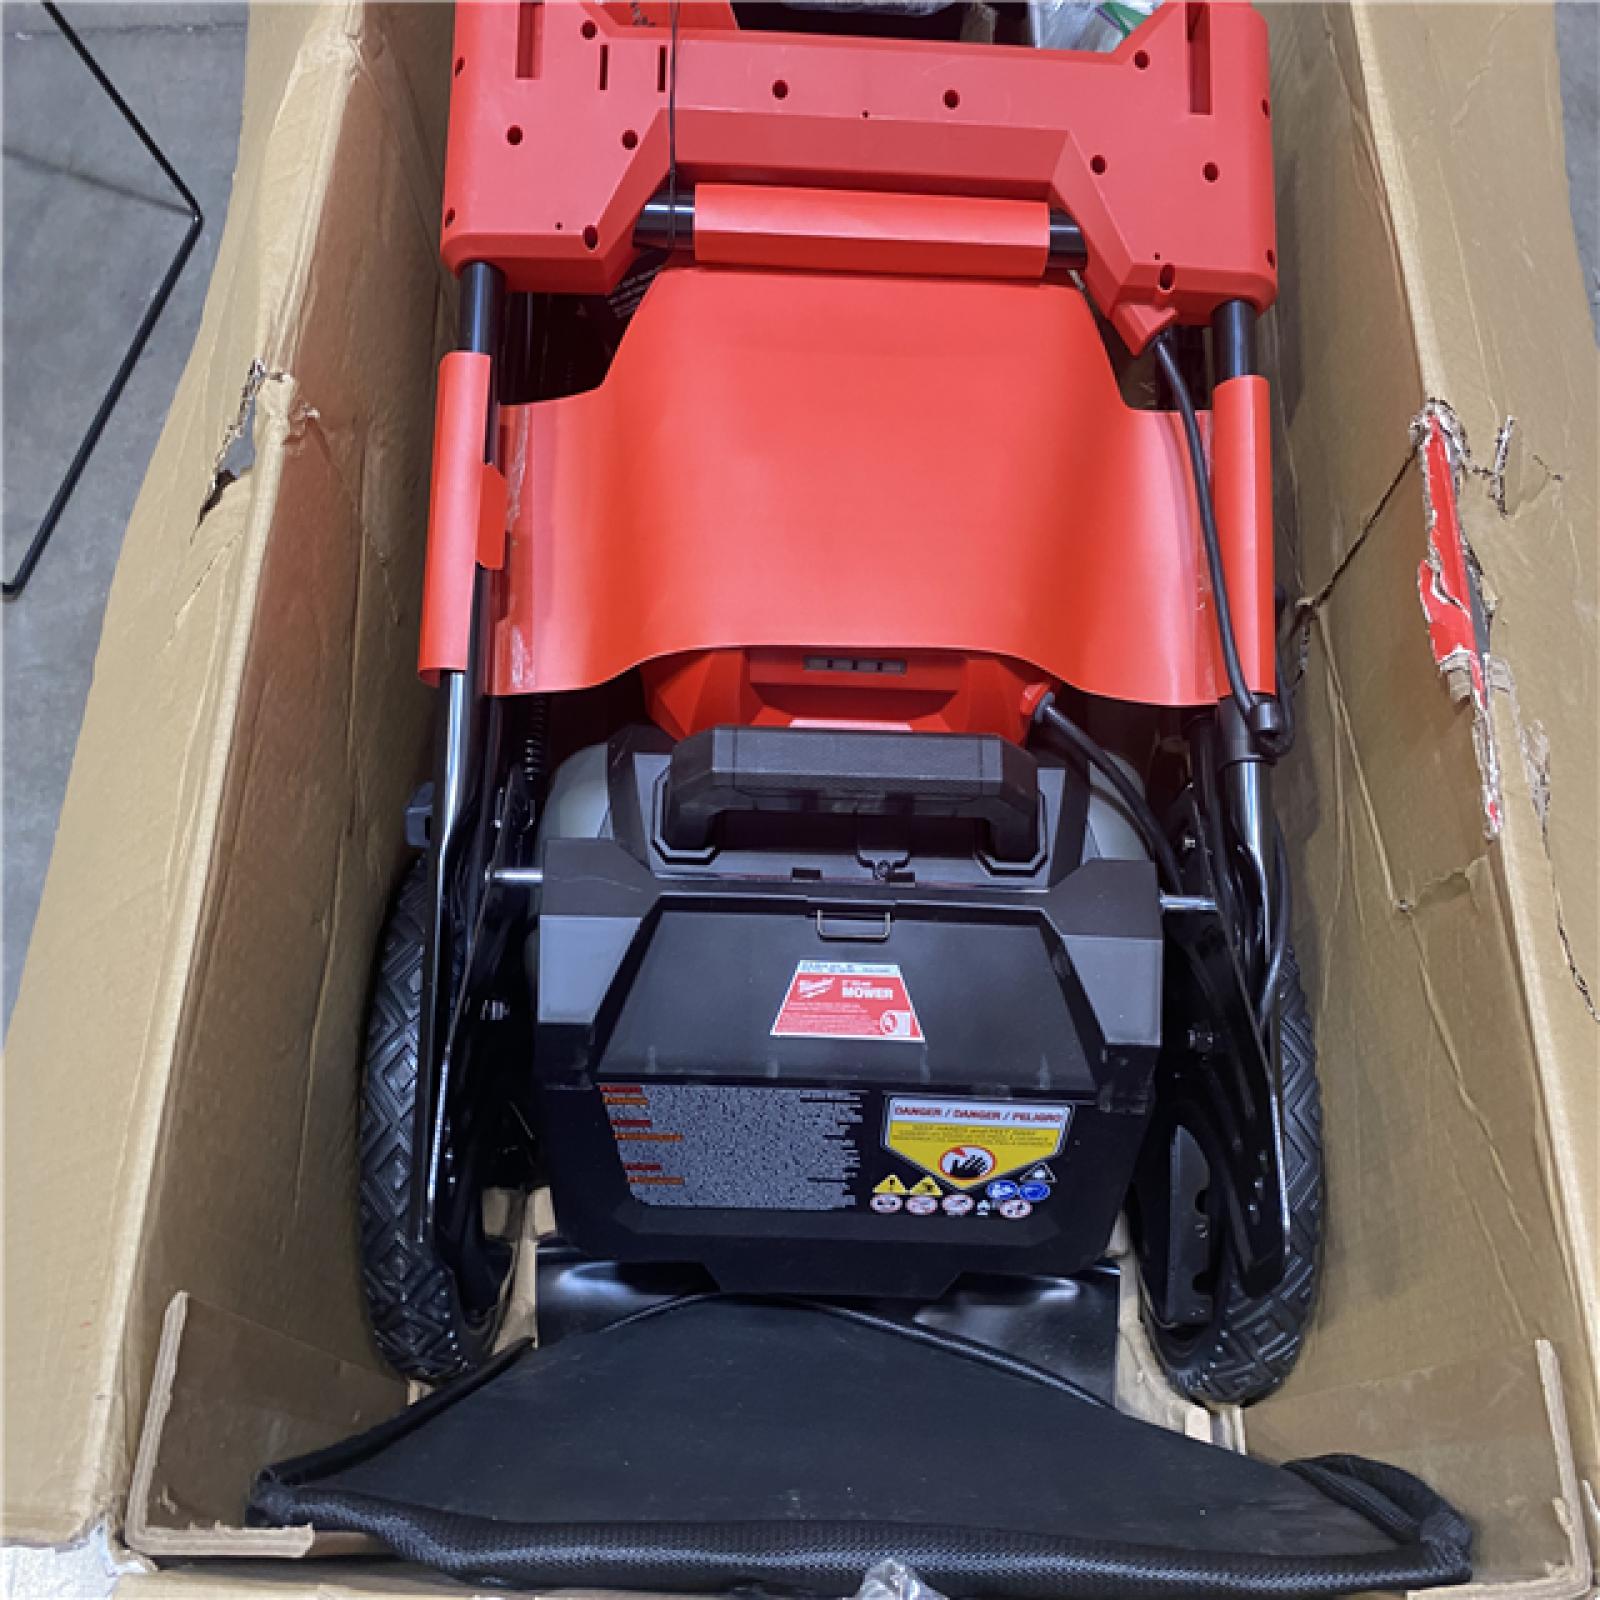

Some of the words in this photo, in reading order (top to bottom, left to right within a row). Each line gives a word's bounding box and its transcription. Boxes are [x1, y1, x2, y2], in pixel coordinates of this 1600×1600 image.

[894, 1106, 942, 1117] DANGER
[953, 1108, 1001, 1120] DANGER
[1012, 1111, 1063, 1122] PELIGRO
